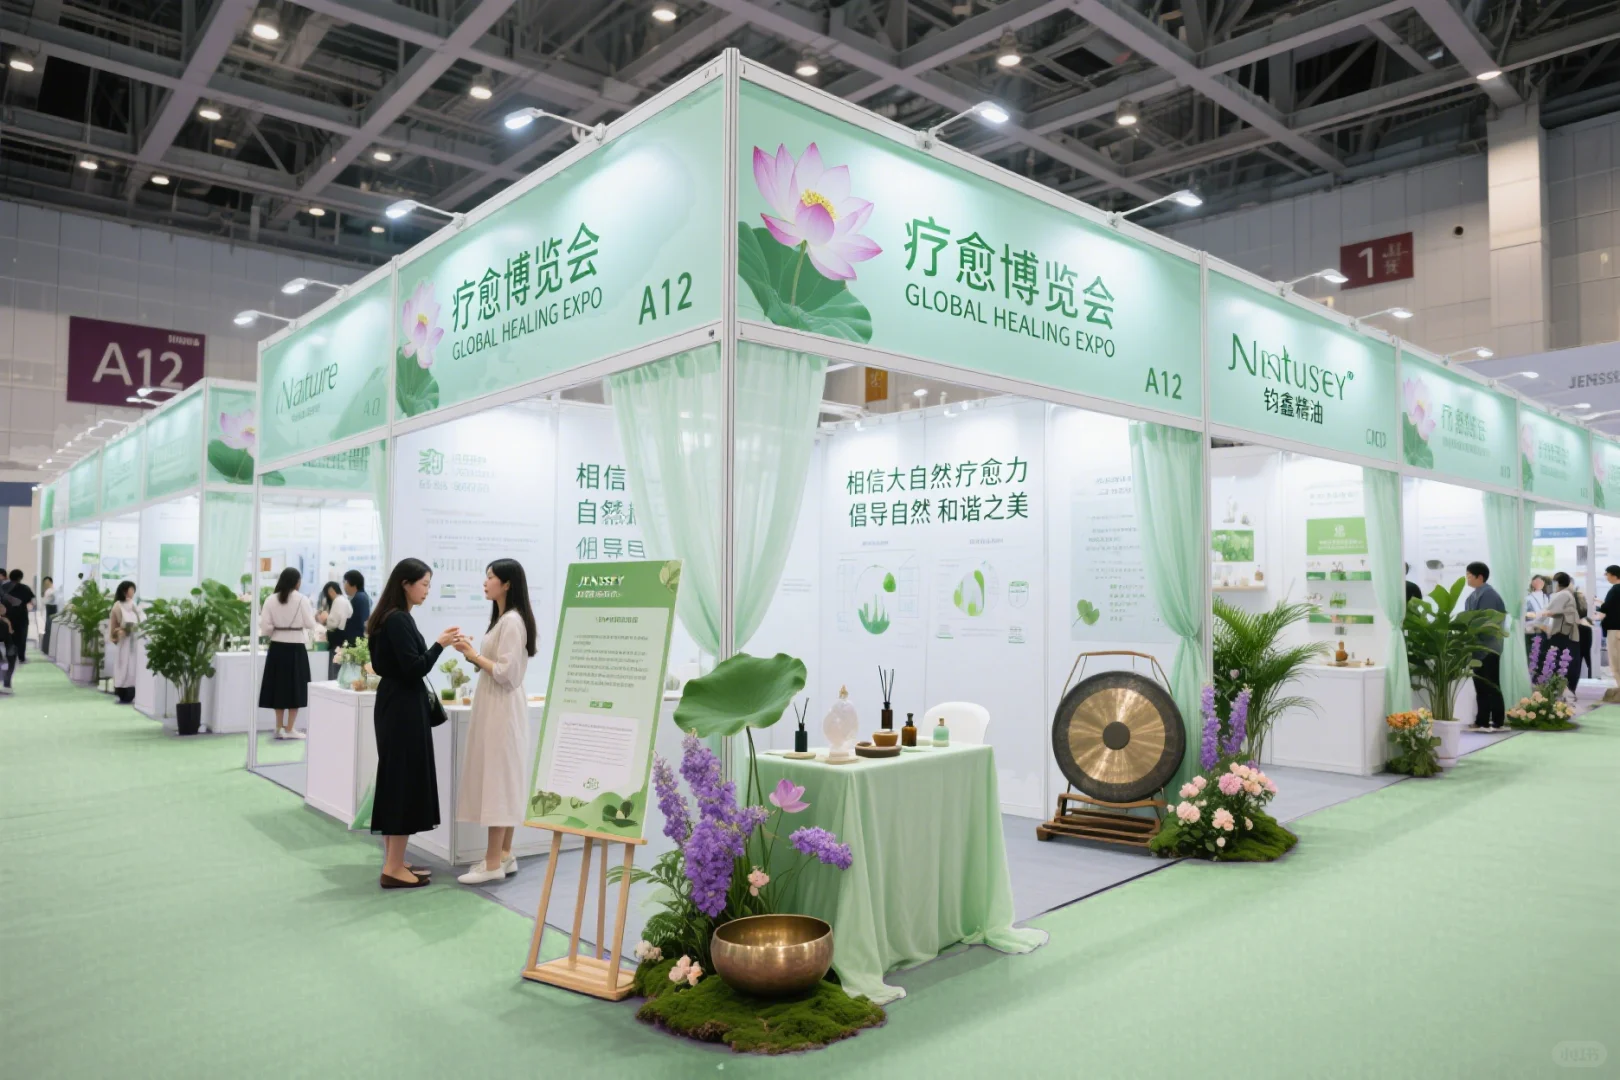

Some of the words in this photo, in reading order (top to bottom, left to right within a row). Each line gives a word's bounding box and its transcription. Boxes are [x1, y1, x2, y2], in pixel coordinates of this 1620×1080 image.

[452, 222, 600, 332] 疗愈博览会
[904, 216, 1115, 330] 疗愈博览会
[1358, 247, 1374, 278] 1
[638, 272, 693, 326] A12
[905, 283, 988, 325] GLOBAL
[994, 307, 1070, 348] HEALING
[1075, 331, 1116, 358] EXPO
[452, 325, 498, 361] GLOBAL
[501, 304, 559, 344] HEALING
[562, 286, 603, 322] EXPO
[92, 342, 184, 390] A12
[1145, 366, 1183, 401] A12
[576, 461, 627, 491] 相信
[846, 456, 1029, 496] 相信大自然疗愈力
[848, 497, 932, 528] 倡导自然
[937, 491, 1030, 525] 和谐之美
